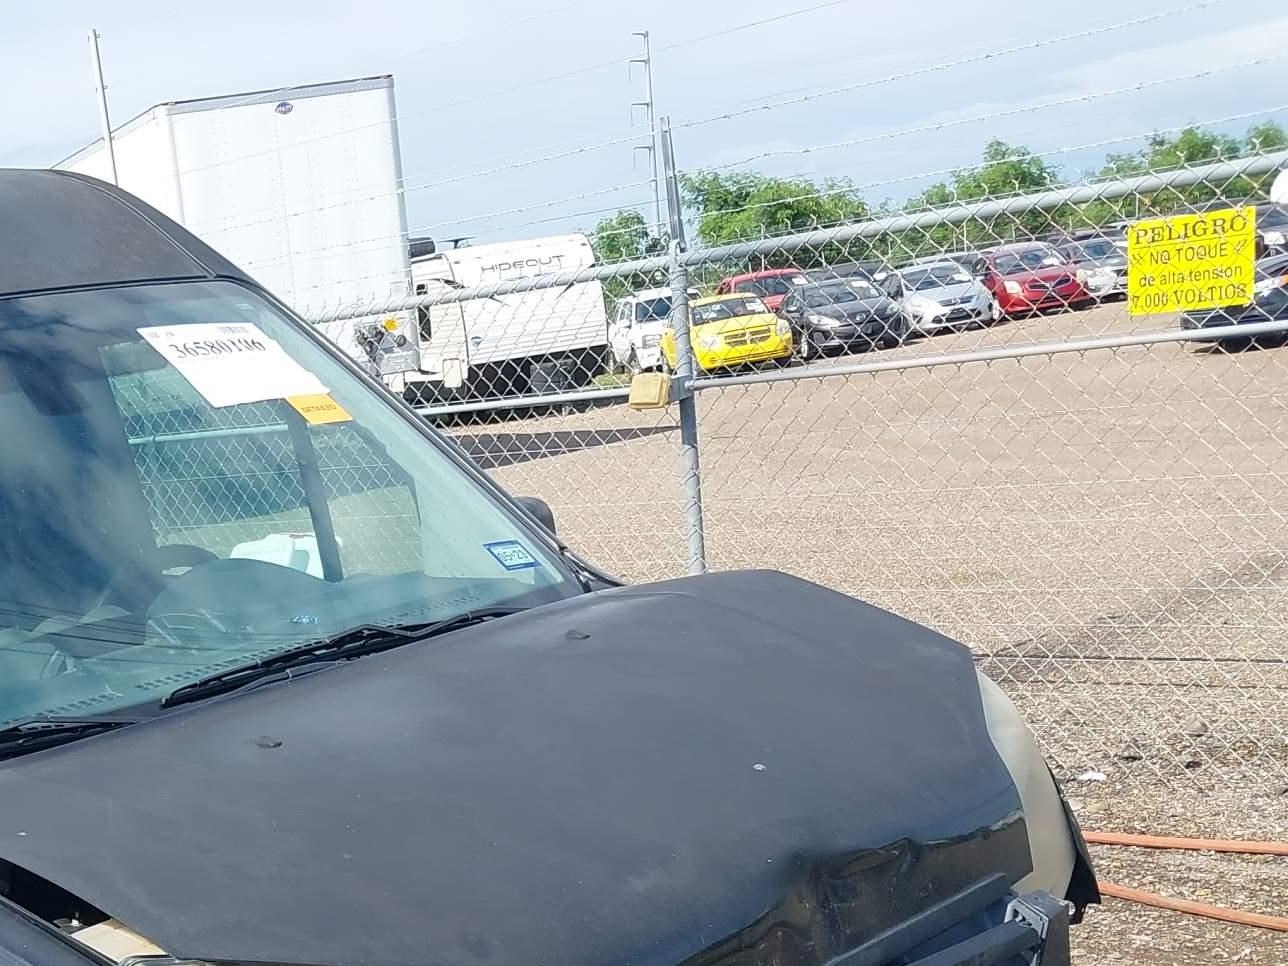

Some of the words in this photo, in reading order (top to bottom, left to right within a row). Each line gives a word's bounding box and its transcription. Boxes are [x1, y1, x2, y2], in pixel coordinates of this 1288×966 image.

[1135, 213, 1248, 245] PELIGRO
[481, 254, 565, 273] HIDEOUT
[1150, 250, 1171, 265] NO
[1176, 242, 1228, 263] TOQUE
[1139, 275, 1156, 288] de
[1160, 271, 1185, 285] alta
[1173, 283, 1248, 305] VOLTIOS
[168, 338, 266, 359] 36580106
